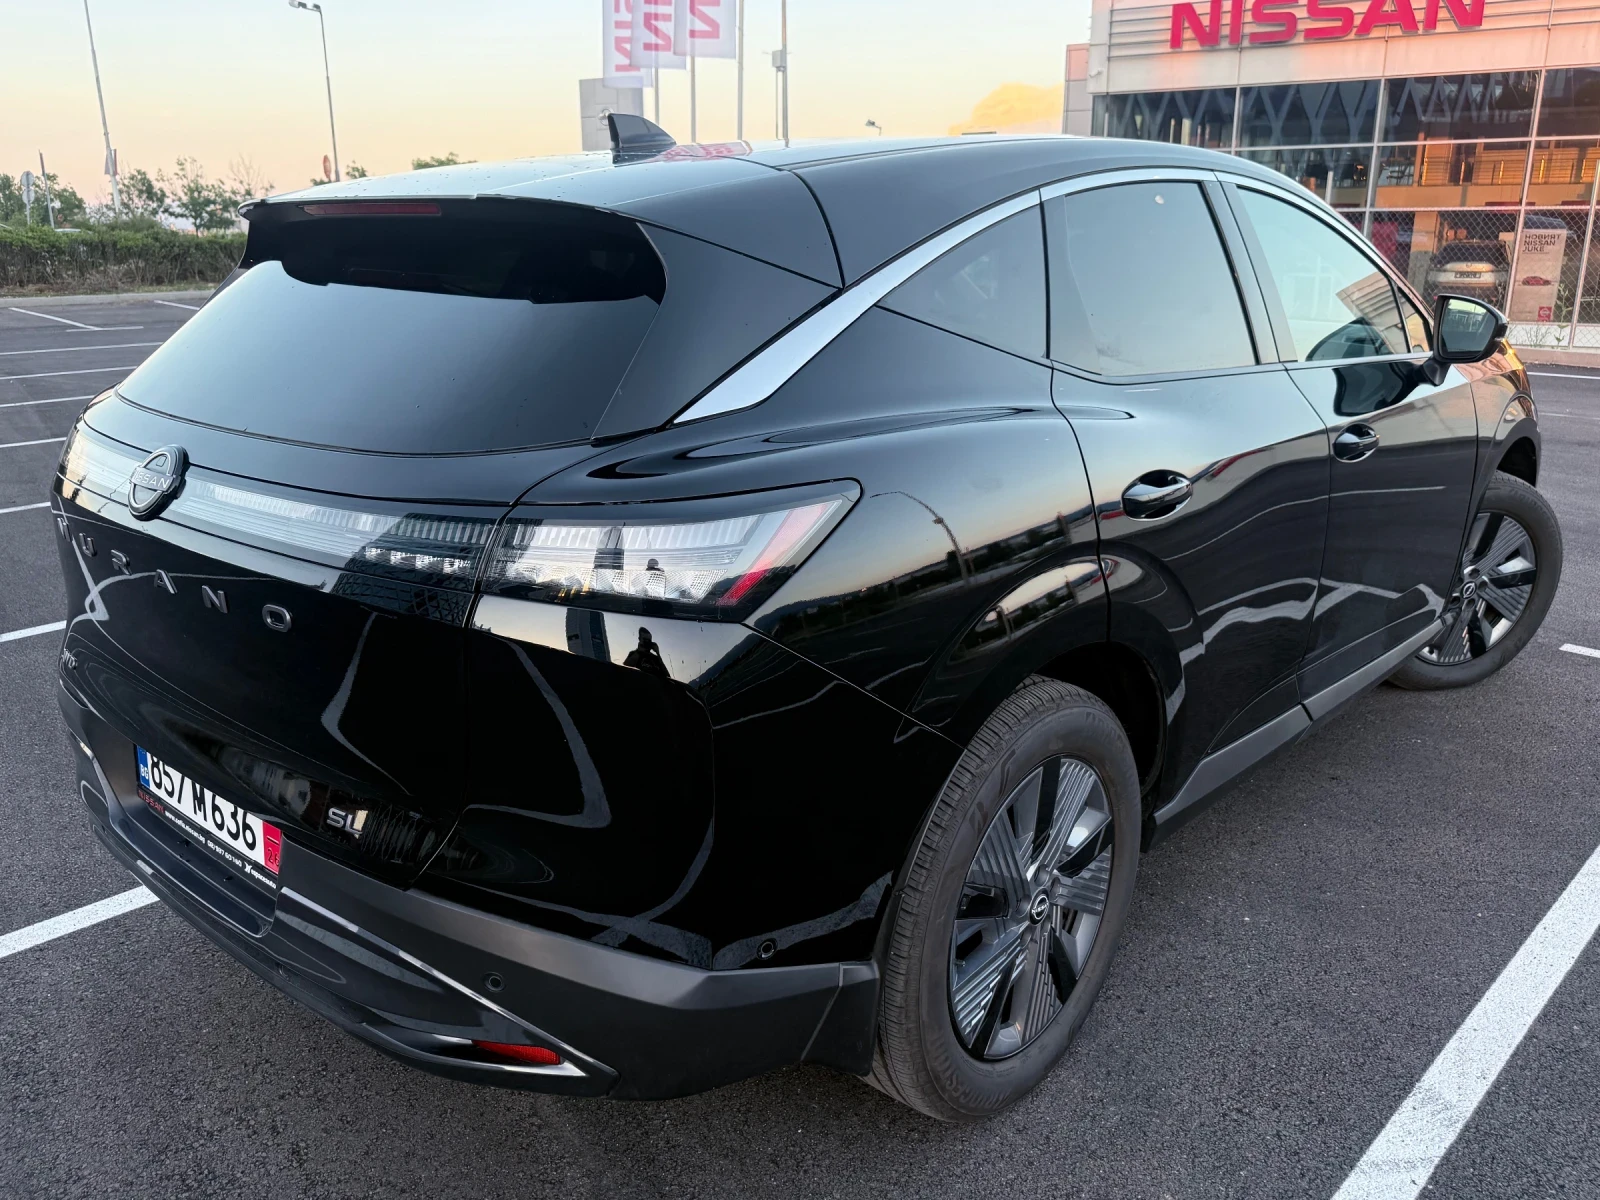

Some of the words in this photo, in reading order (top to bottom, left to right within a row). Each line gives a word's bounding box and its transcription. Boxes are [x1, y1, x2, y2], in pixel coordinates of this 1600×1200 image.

[1169, 0, 1485, 49] NISSAN
[1523, 239, 1556, 247] NISSAN
[1524, 233, 1561, 241] НОВИЯТ
[1522, 245, 1546, 253] JUKE
[57, 517, 293, 633] MURANO
[140, 763, 149, 780] BG
[137, 789, 165, 814] NISSAN
[326, 806, 364, 836] SL
